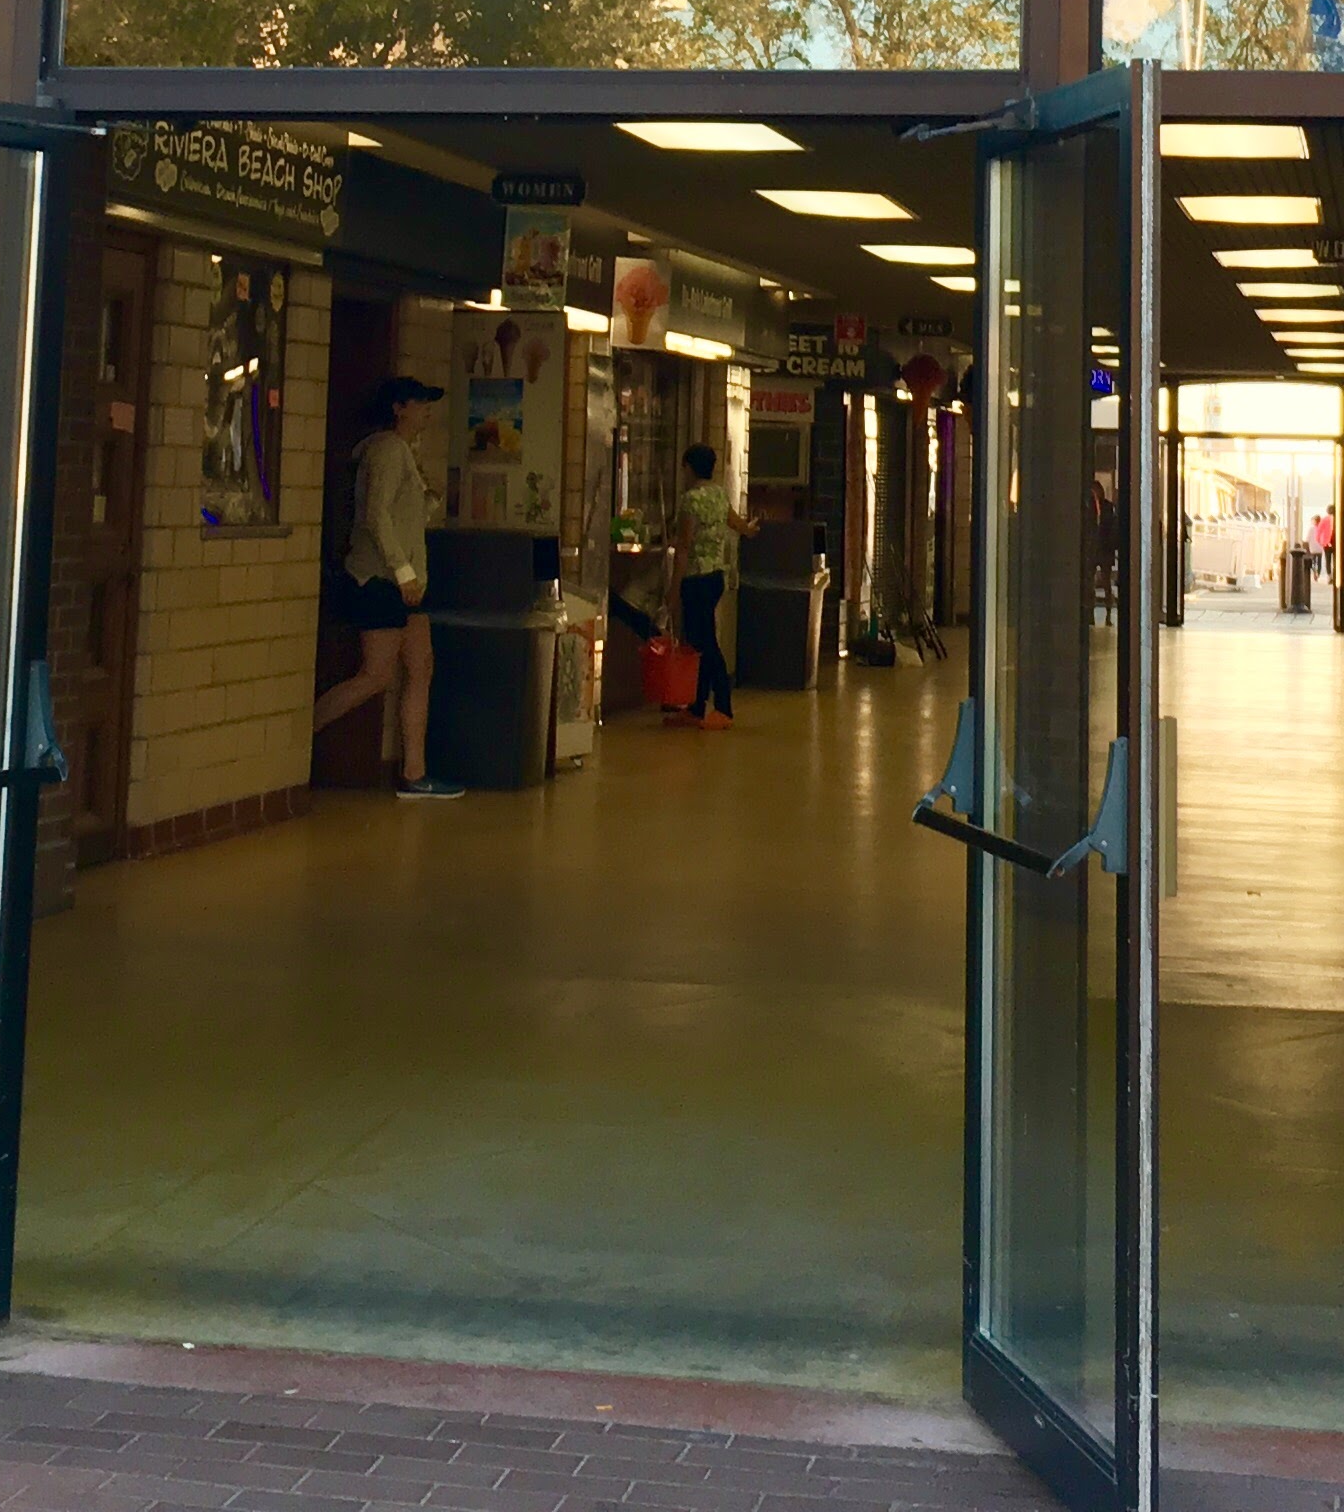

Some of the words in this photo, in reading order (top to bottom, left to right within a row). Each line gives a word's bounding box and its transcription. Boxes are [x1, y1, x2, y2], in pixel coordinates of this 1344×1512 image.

[239, 145, 295, 191] BEACH
[303, 166, 342, 206] SHOP
[502, 181, 574, 197] WOMEN
[786, 356, 866, 377] CREAM
